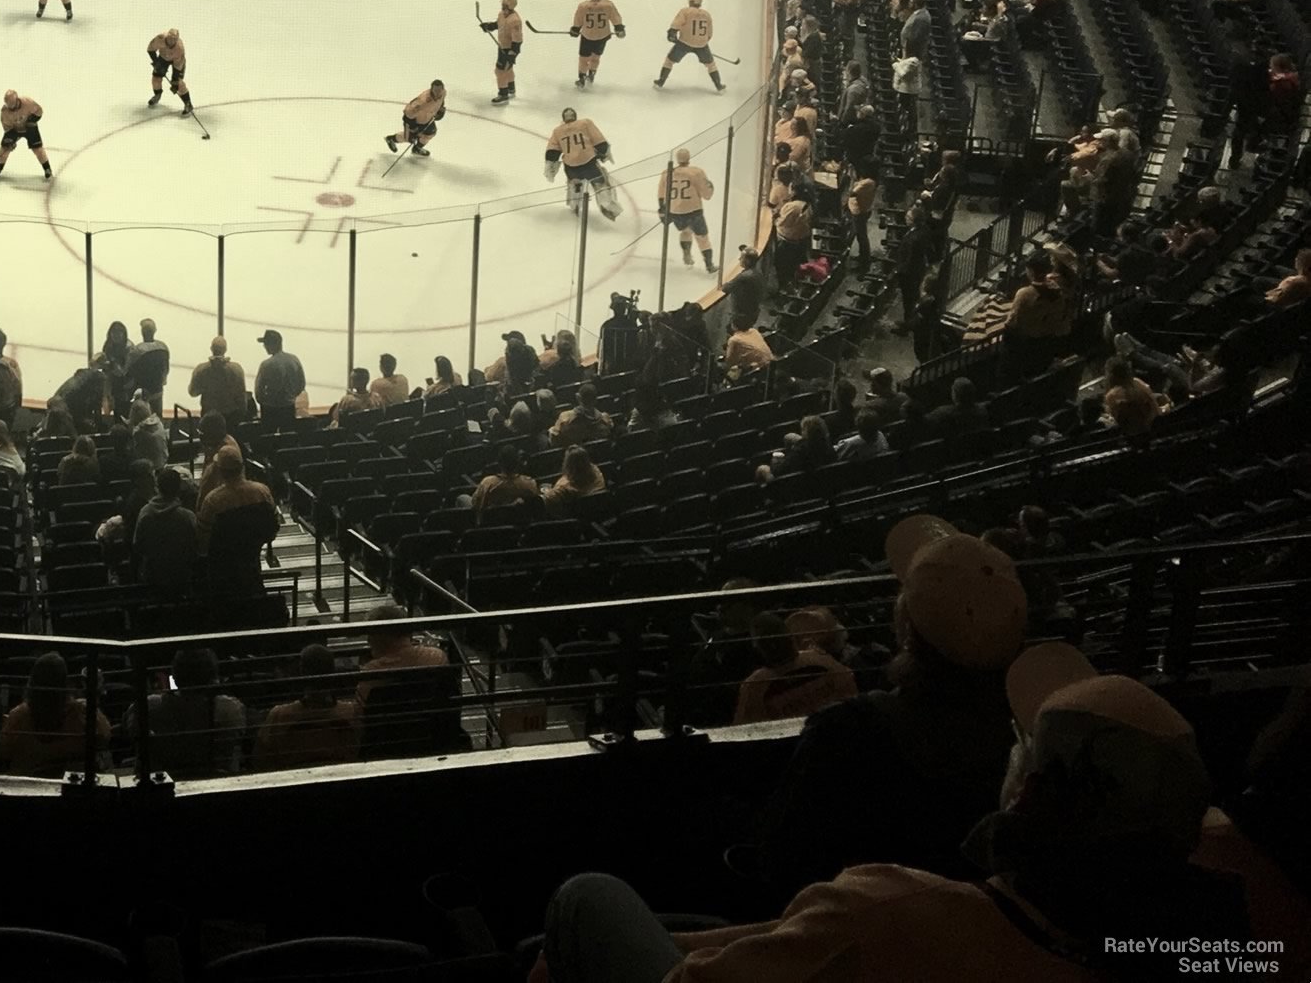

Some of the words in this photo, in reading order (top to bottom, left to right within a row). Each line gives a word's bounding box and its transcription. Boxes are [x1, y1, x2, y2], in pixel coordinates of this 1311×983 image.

[584, 13, 607, 29] 55
[691, 20, 707, 36] 15
[561, 132, 588, 154] 74
